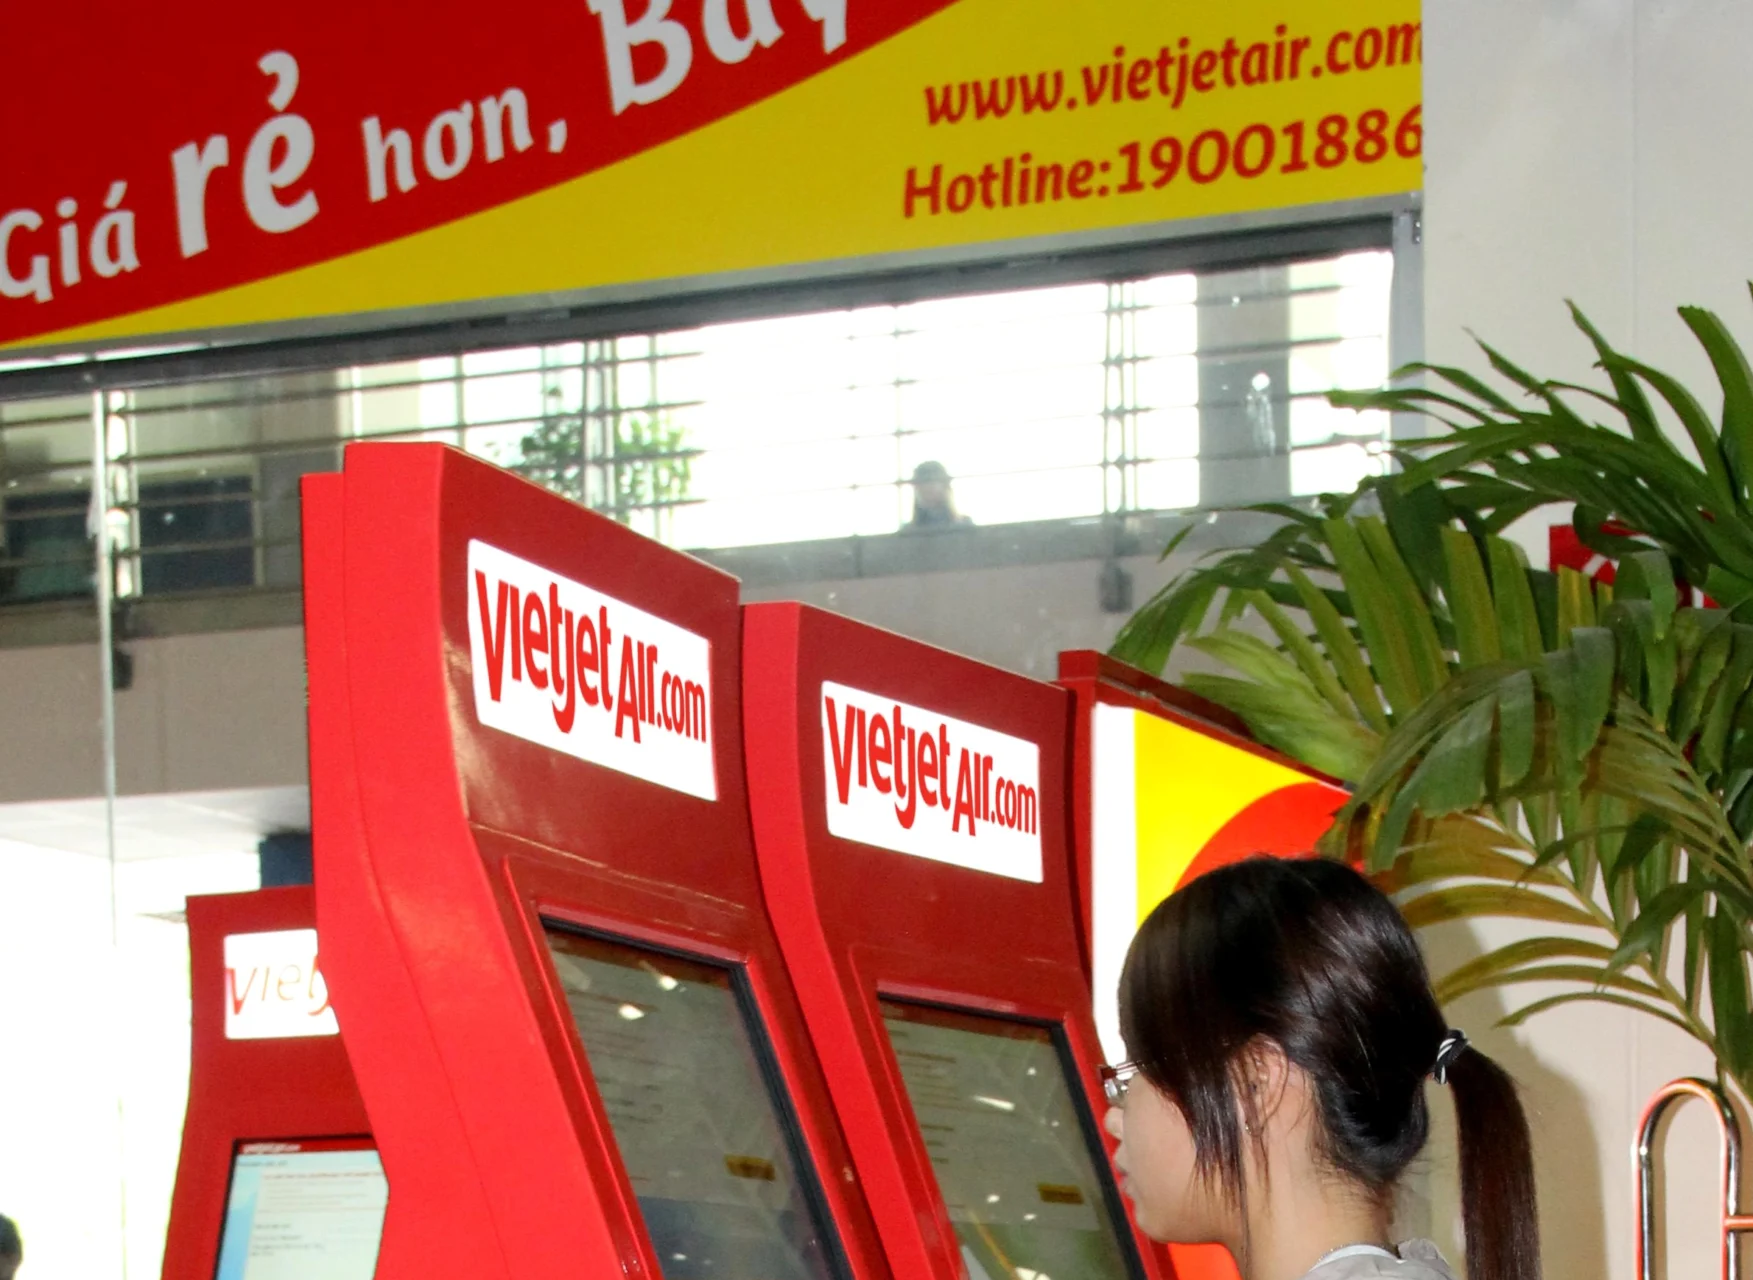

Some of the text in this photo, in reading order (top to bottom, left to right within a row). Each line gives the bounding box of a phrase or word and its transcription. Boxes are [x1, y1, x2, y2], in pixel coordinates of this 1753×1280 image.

[924, 19, 1422, 127] www.vietjetair.com
[0, 181, 141, 303] Giá
[171, 51, 320, 259] rẻ
[362, 87, 568, 203] hơn,
